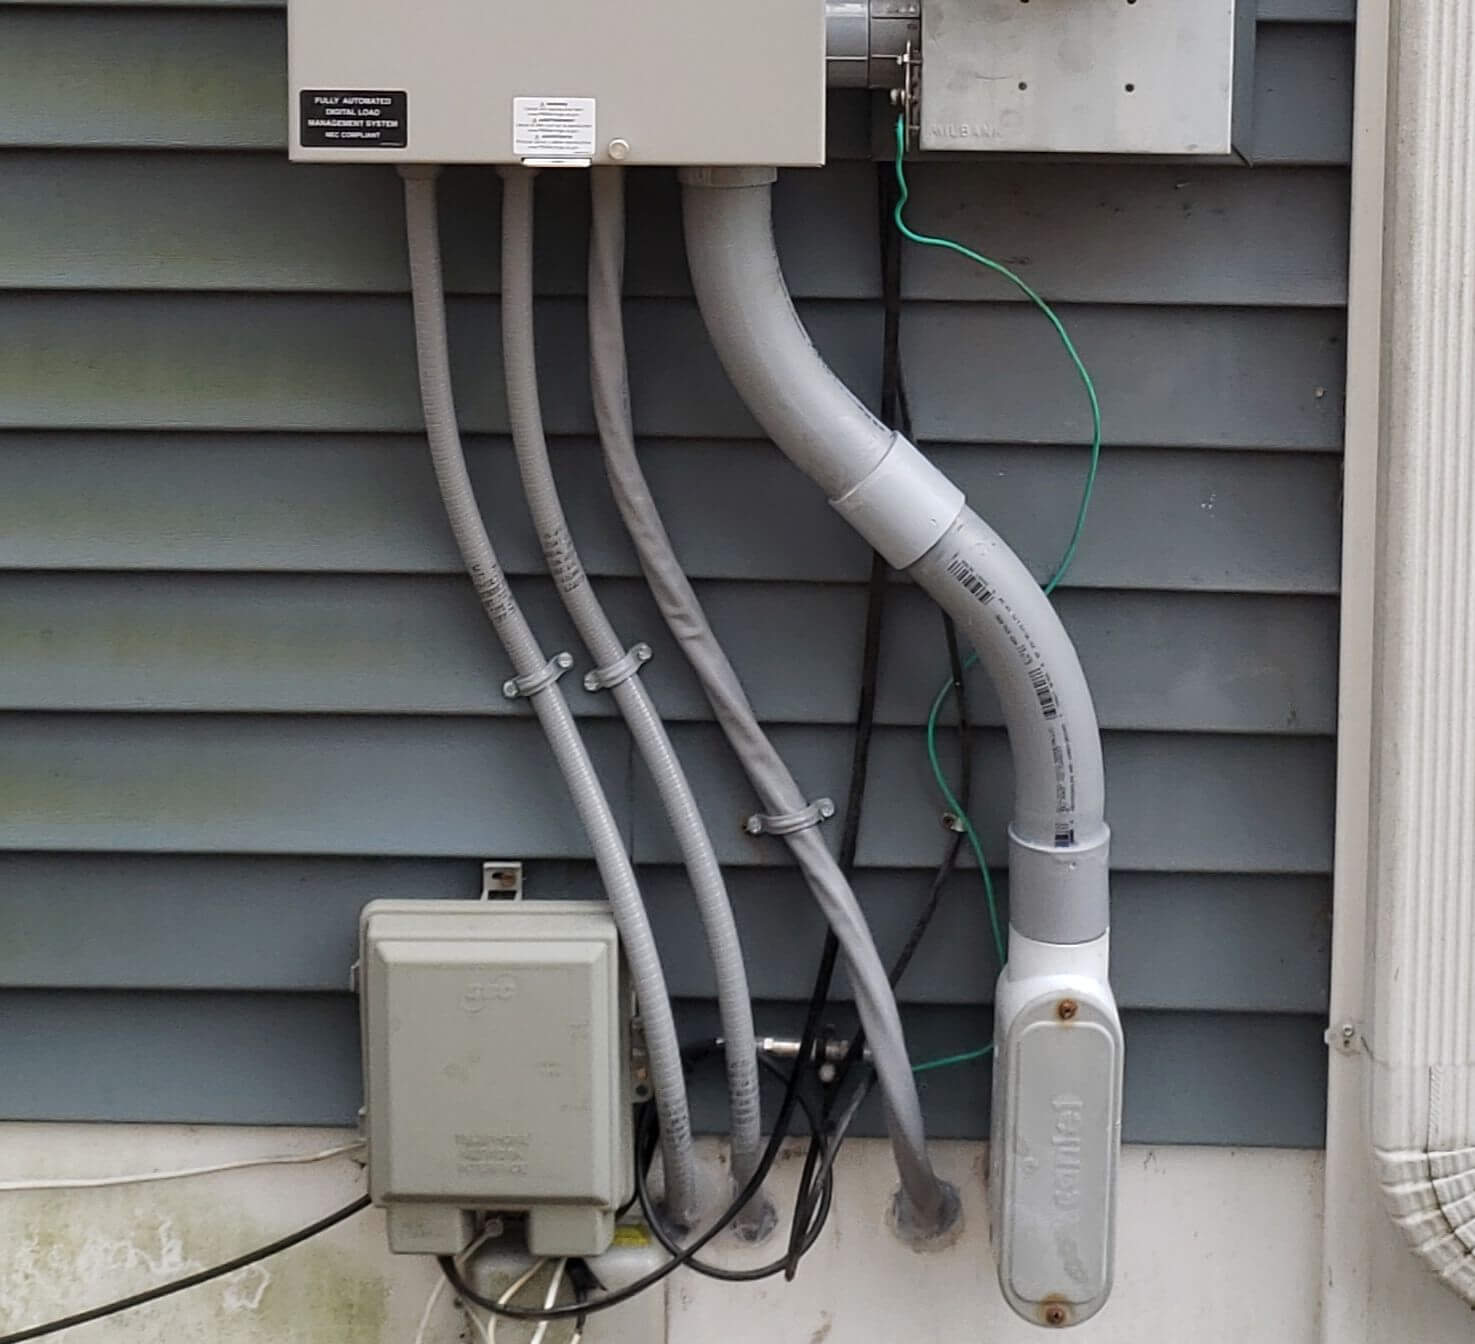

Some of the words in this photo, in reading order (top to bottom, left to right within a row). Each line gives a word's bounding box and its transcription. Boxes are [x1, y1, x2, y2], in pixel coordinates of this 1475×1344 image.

[314, 96, 339, 104] FULLY
[342, 97, 392, 105] AUTOMATED
[325, 108, 356, 116] DIGITAL
[358, 108, 381, 116] LOAD
[307, 119, 363, 127] MANAGEMENT
[365, 120, 399, 128] SYSTEM
[341, 131, 381, 139] COMPLIANT
